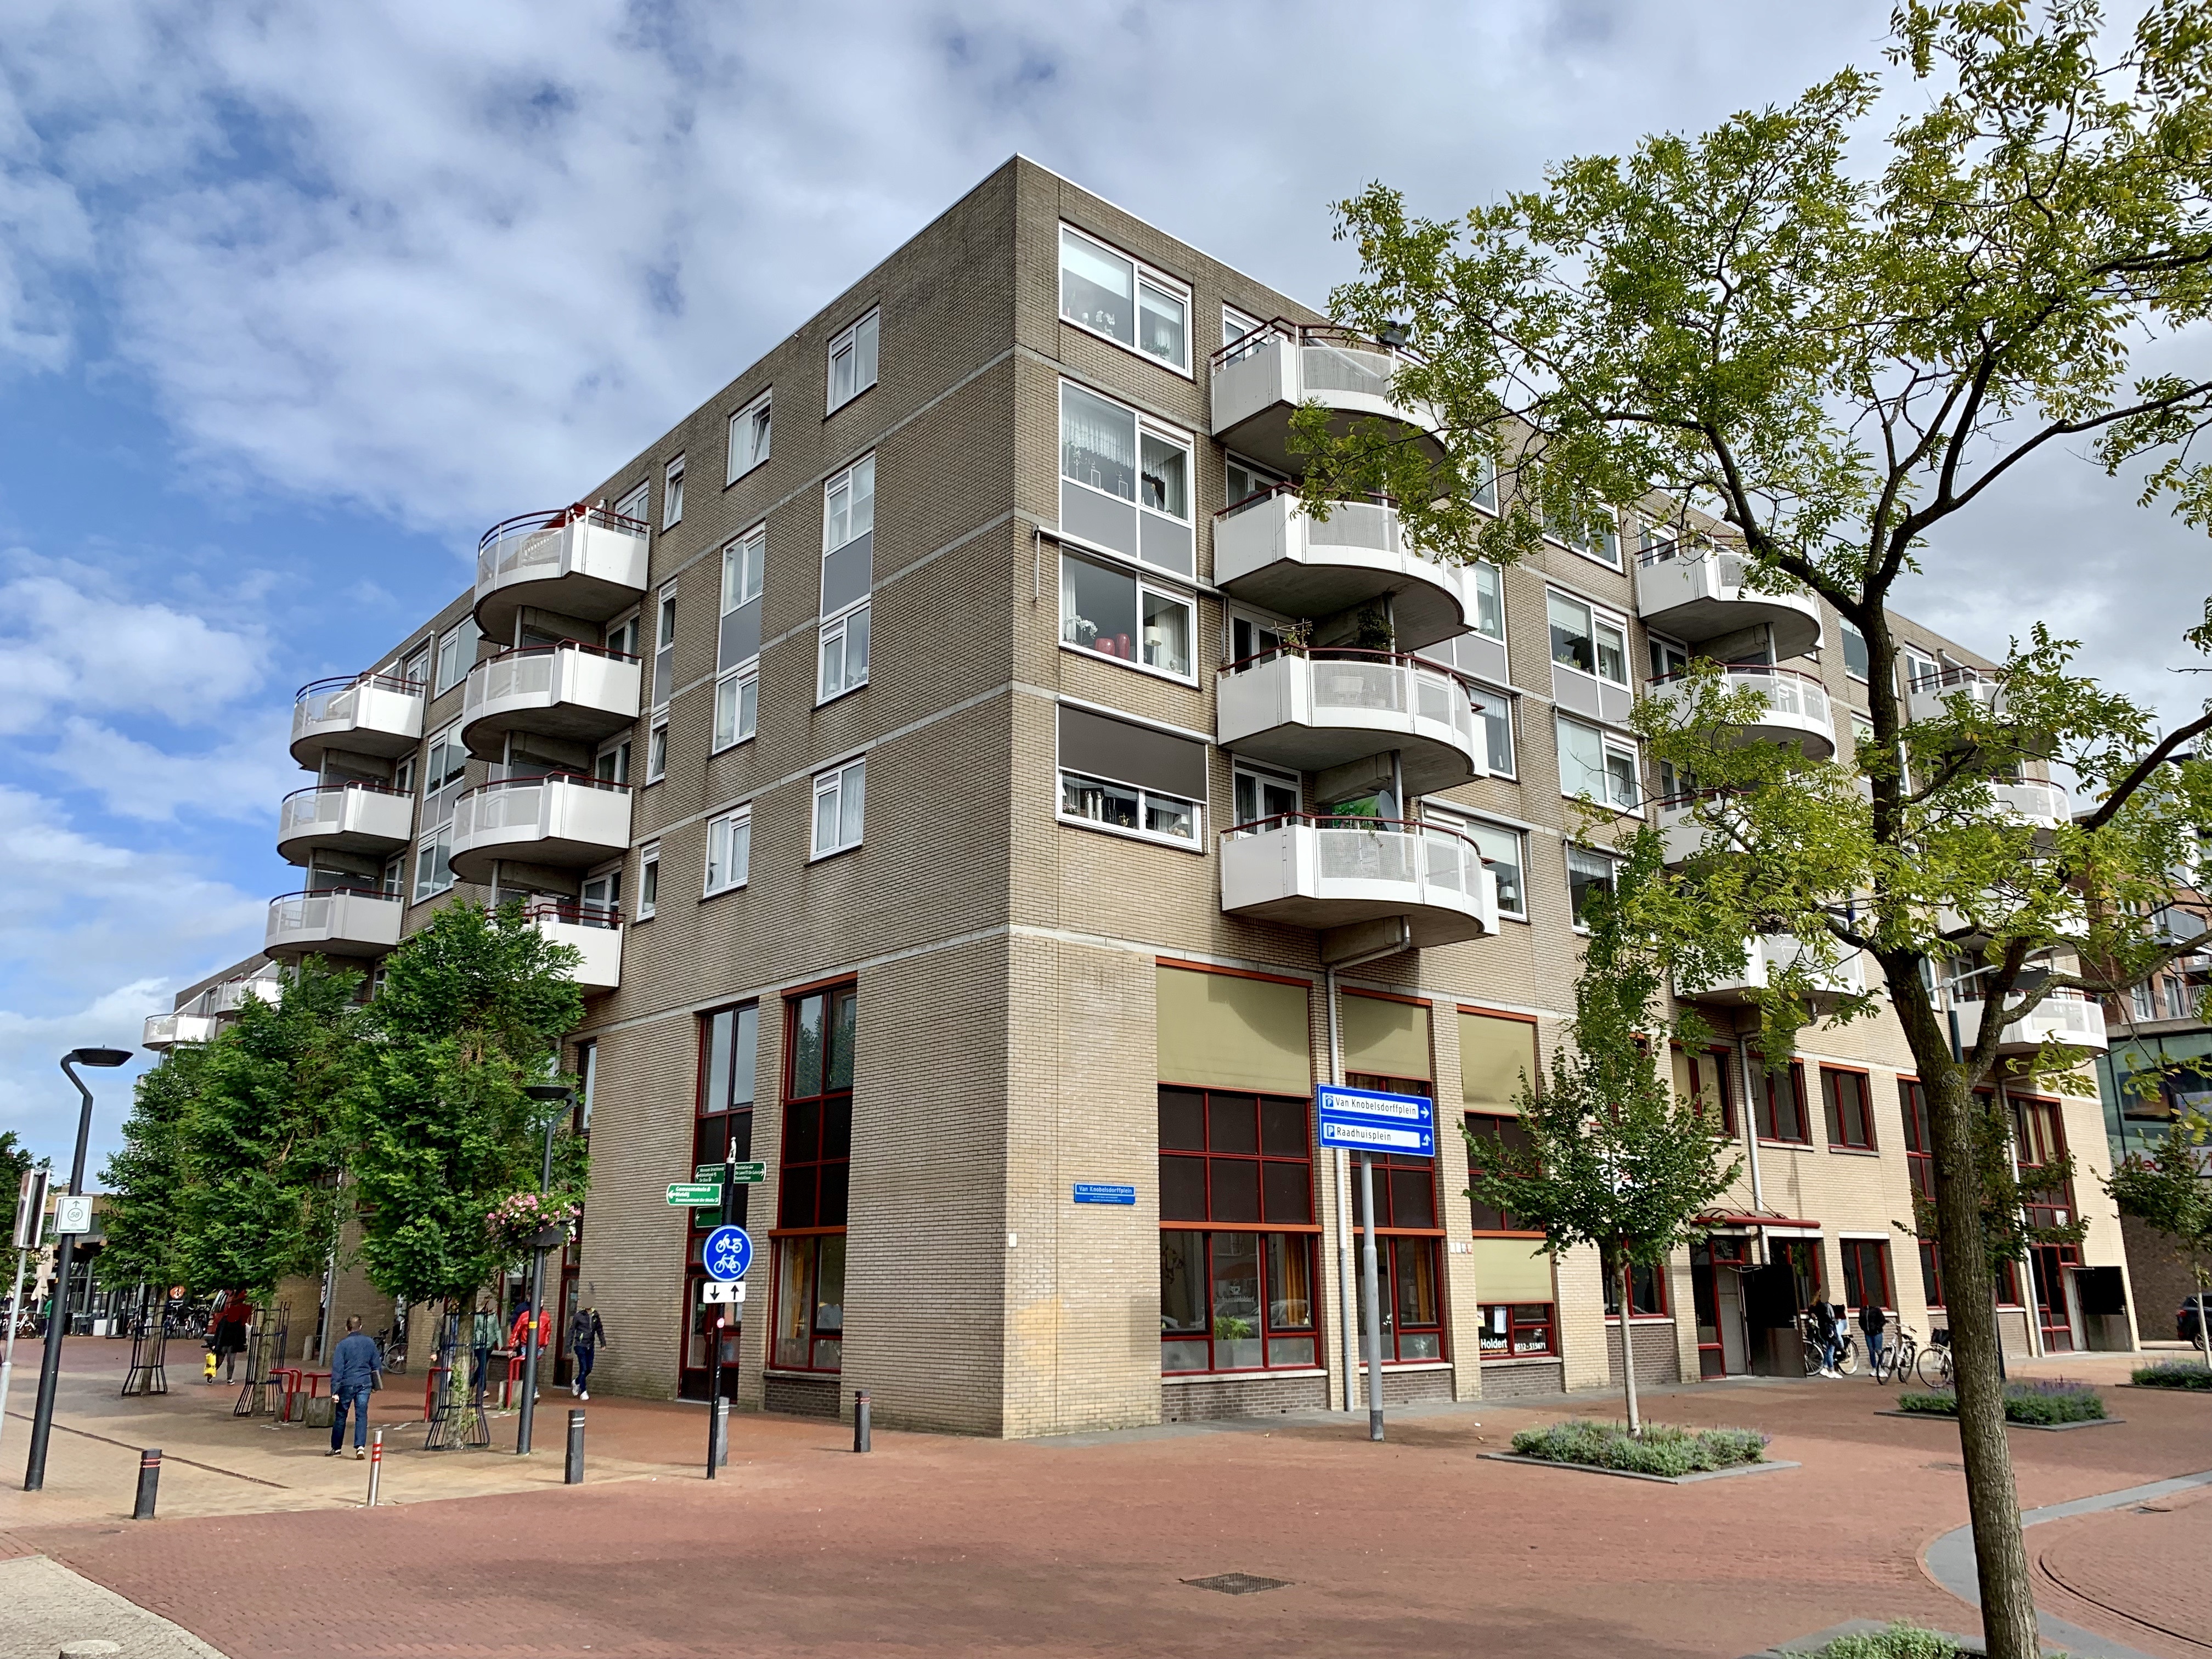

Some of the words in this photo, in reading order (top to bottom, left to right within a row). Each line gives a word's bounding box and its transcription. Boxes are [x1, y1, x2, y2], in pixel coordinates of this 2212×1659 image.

[1335, 1097, 1349, 1107] Van
[1351, 1099, 1417, 1115] Knobelsdorffplein
[1337, 1127, 1391, 1141] Raadhuisplein
[1481, 1339, 1507, 1349] Holdert
